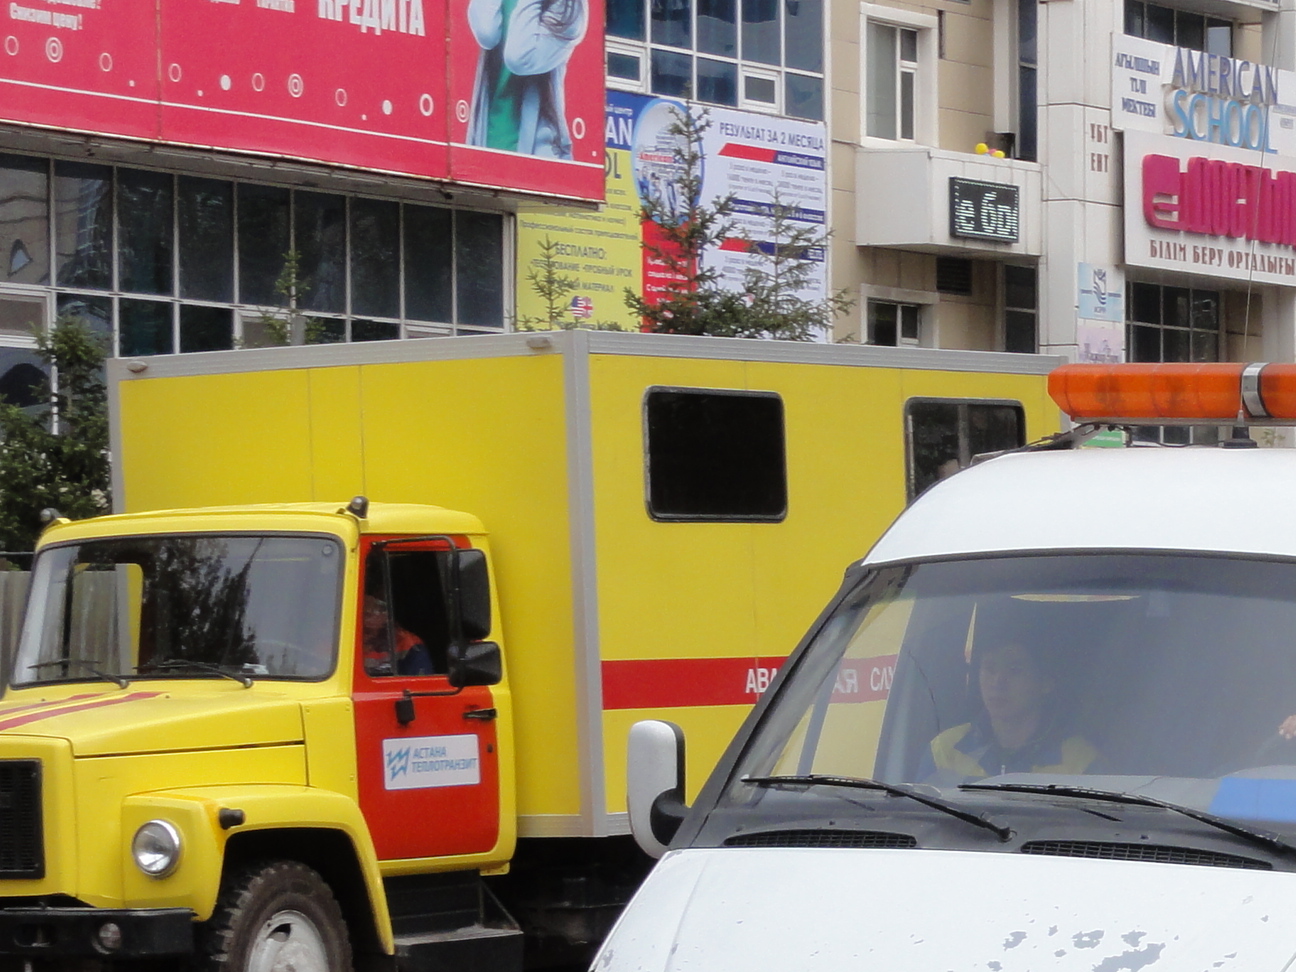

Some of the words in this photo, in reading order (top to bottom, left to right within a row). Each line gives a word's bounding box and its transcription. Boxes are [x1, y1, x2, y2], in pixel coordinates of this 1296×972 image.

[1172, 47, 1277, 104] AMERICAN
[1173, 89, 1278, 154] SCHOOL
[1150, 239, 1187, 262] БІЛІМ
[1193, 246, 1224, 267] БЕРУ
[412, 758, 477, 772] ТЕПЛОТРАНЗИТ
[413, 747, 447, 759] АСТАНА
